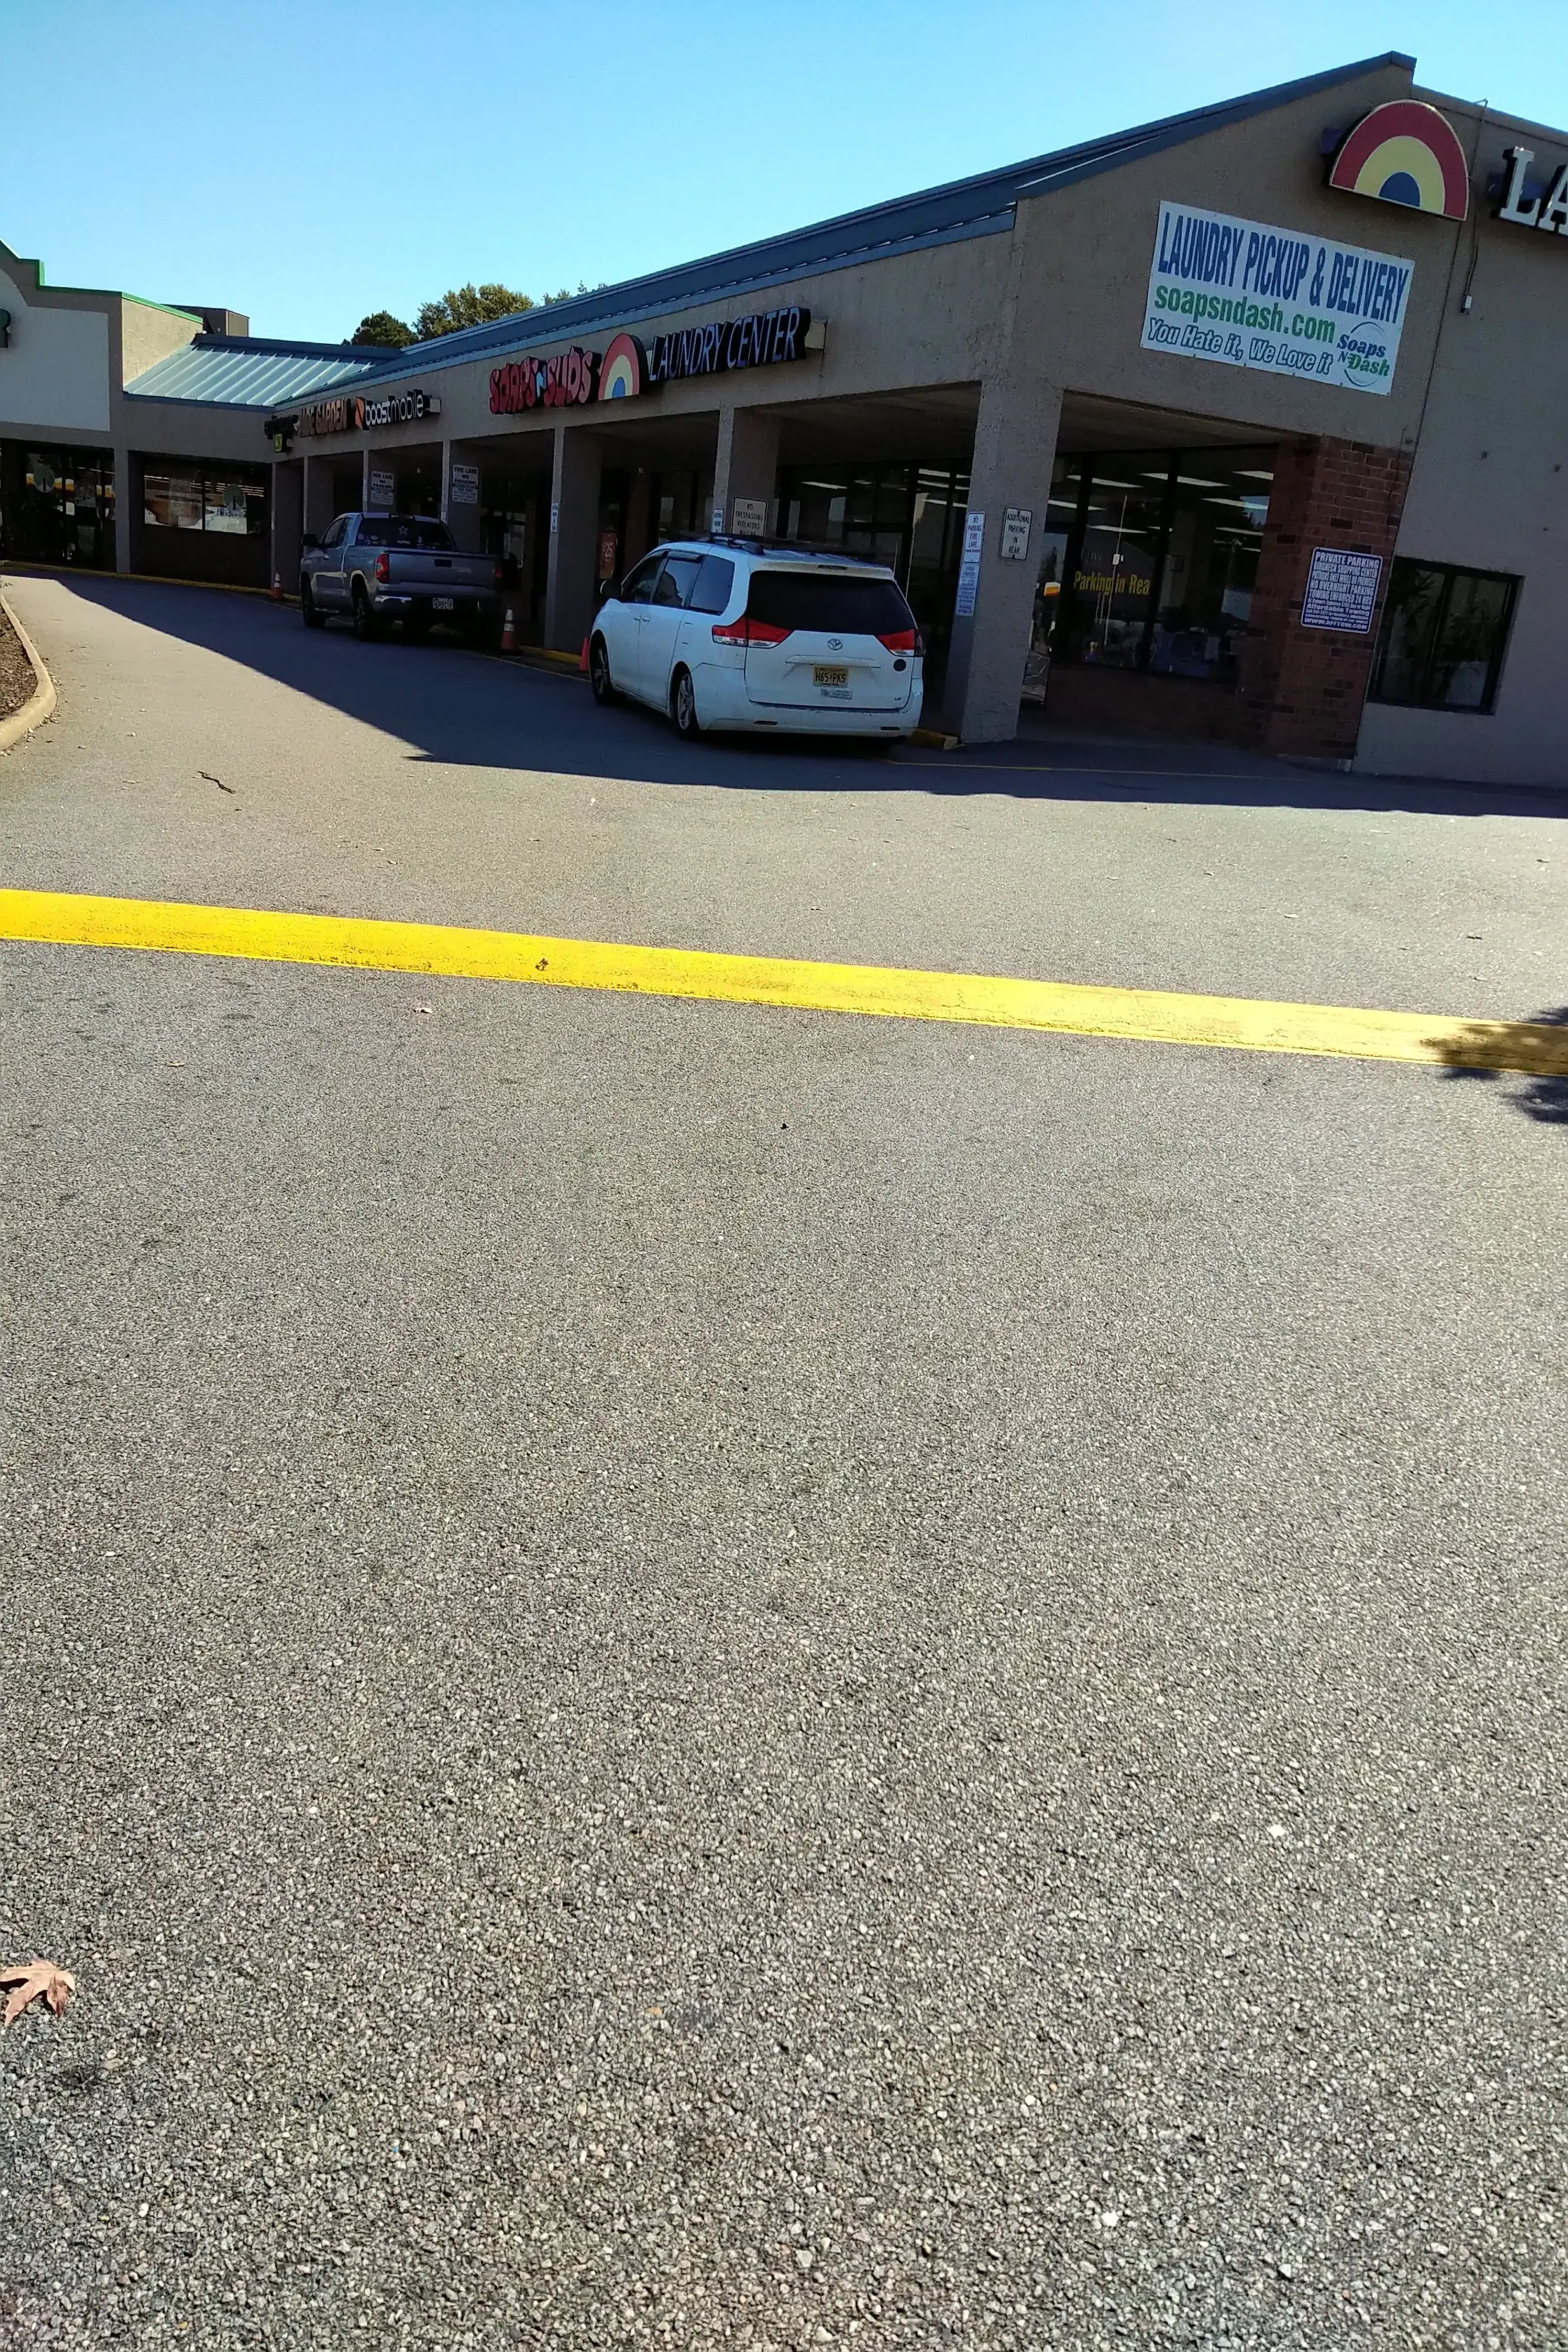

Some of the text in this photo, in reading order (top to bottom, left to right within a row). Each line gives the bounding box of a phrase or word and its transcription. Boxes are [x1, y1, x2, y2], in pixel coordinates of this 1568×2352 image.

[1158, 212, 1409, 324] LAUNDRY PICKUP & DELIVERY
[1154, 285, 1336, 344] soapsndash.com
[649, 306, 801, 381] LAUNDRY CENTER
[1148, 317, 1334, 375] You Hate it, We Love it
[1337, 334, 1386, 358] Soaps
[1347, 353, 1390, 377] Dash
[490, 356, 539, 414] SOAPS
[543, 346, 593, 407] SUDS
[315, 398, 347, 434] GARDEN
[1007, 513, 1030, 524] ADDITIONAL
[1008, 524, 1026, 534] PARKING
[1315, 551, 1380, 569] PRIVATE PARKING
[1074, 570, 1151, 596] Parking in Rea
[1319, 580, 1351, 594] OVERNIGHT
[1351, 584, 1374, 596] PARKING
